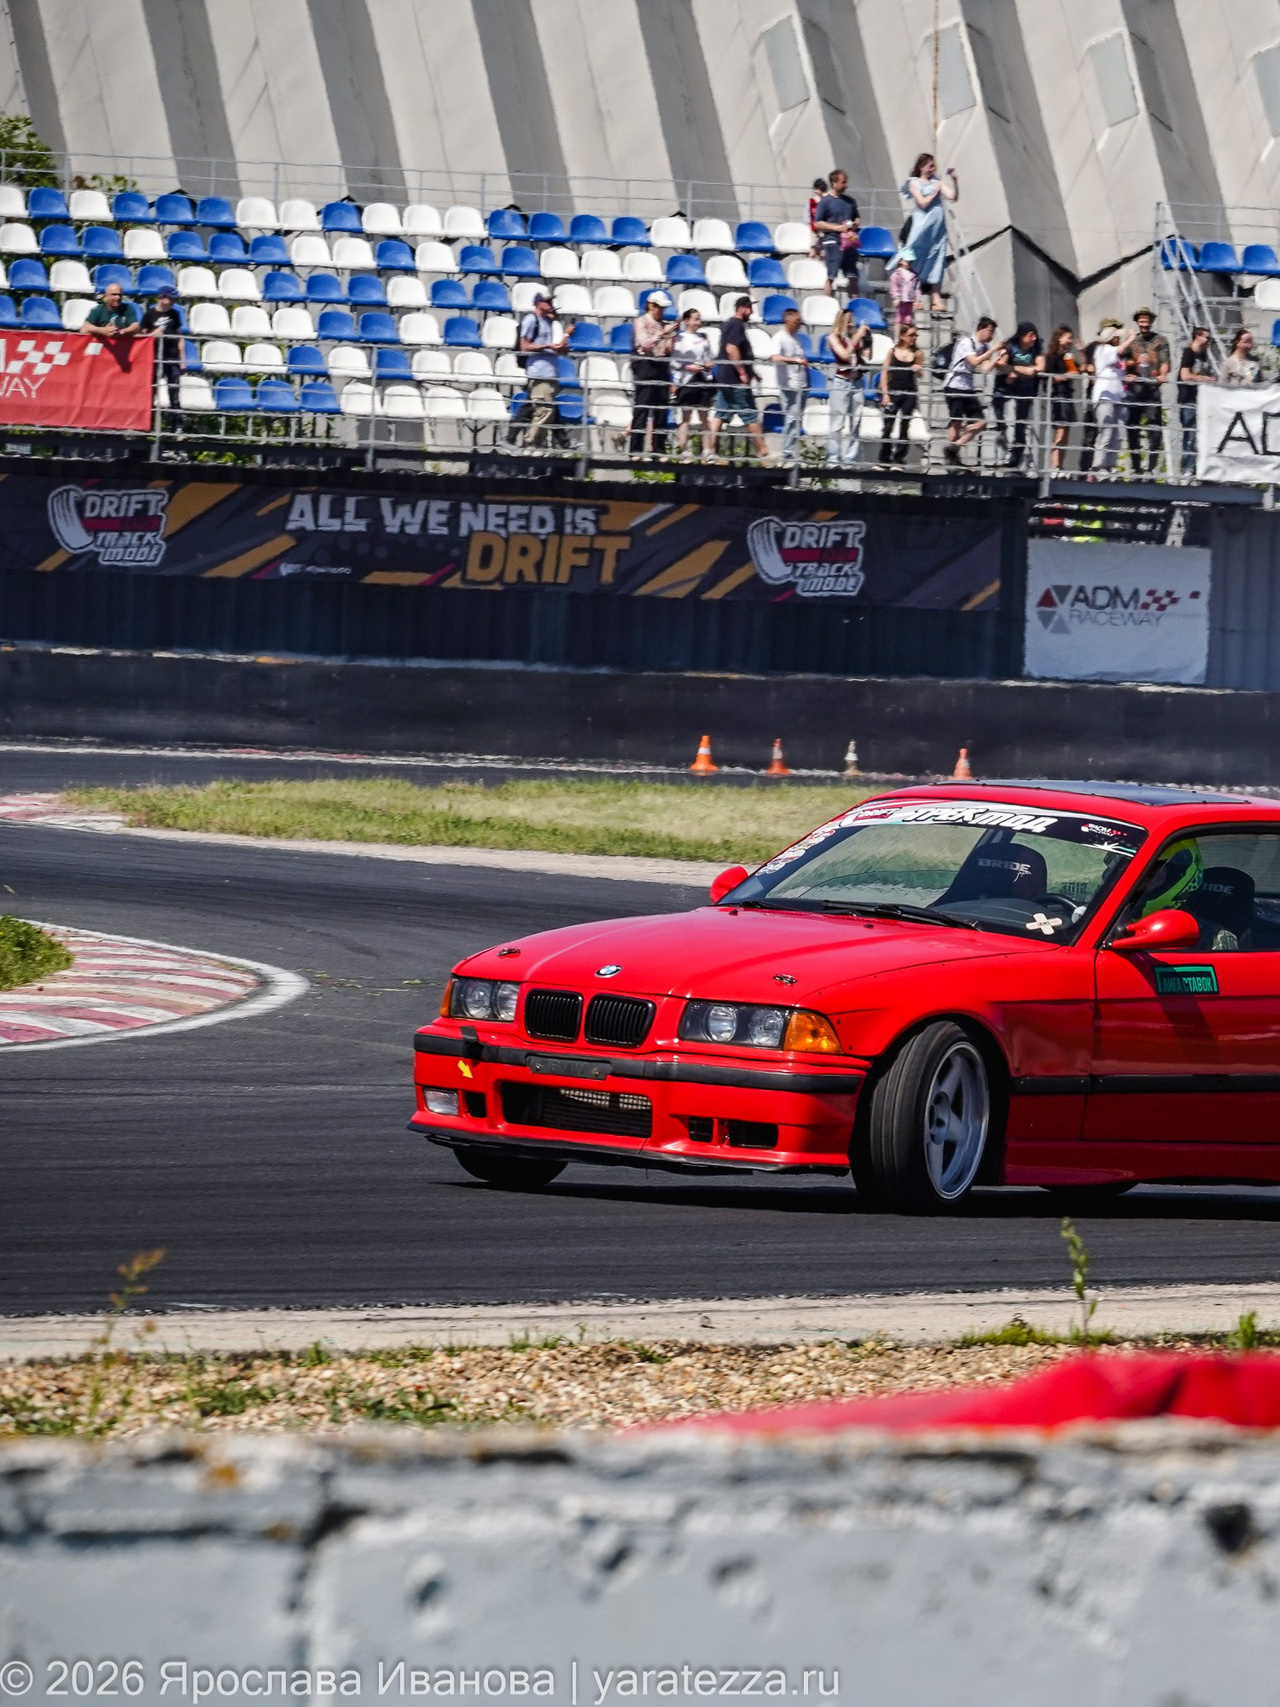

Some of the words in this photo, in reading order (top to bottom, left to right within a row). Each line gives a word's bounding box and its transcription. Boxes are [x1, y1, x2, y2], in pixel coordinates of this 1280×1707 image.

[84, 493, 164, 518] DRIFT
[285, 493, 374, 533] ALL
[380, 497, 451, 536] WE
[459, 501, 556, 540] NEED
[564, 504, 599, 537] IS
[782, 525, 861, 549] DRIFT
[465, 531, 632, 585] DRIFT
[1069, 584, 1140, 611] ADM
[1069, 608, 1165, 627] RACEWAY
[977, 858, 1031, 873] BRIDE
[1182, 976, 1214, 993] СТАВОК
